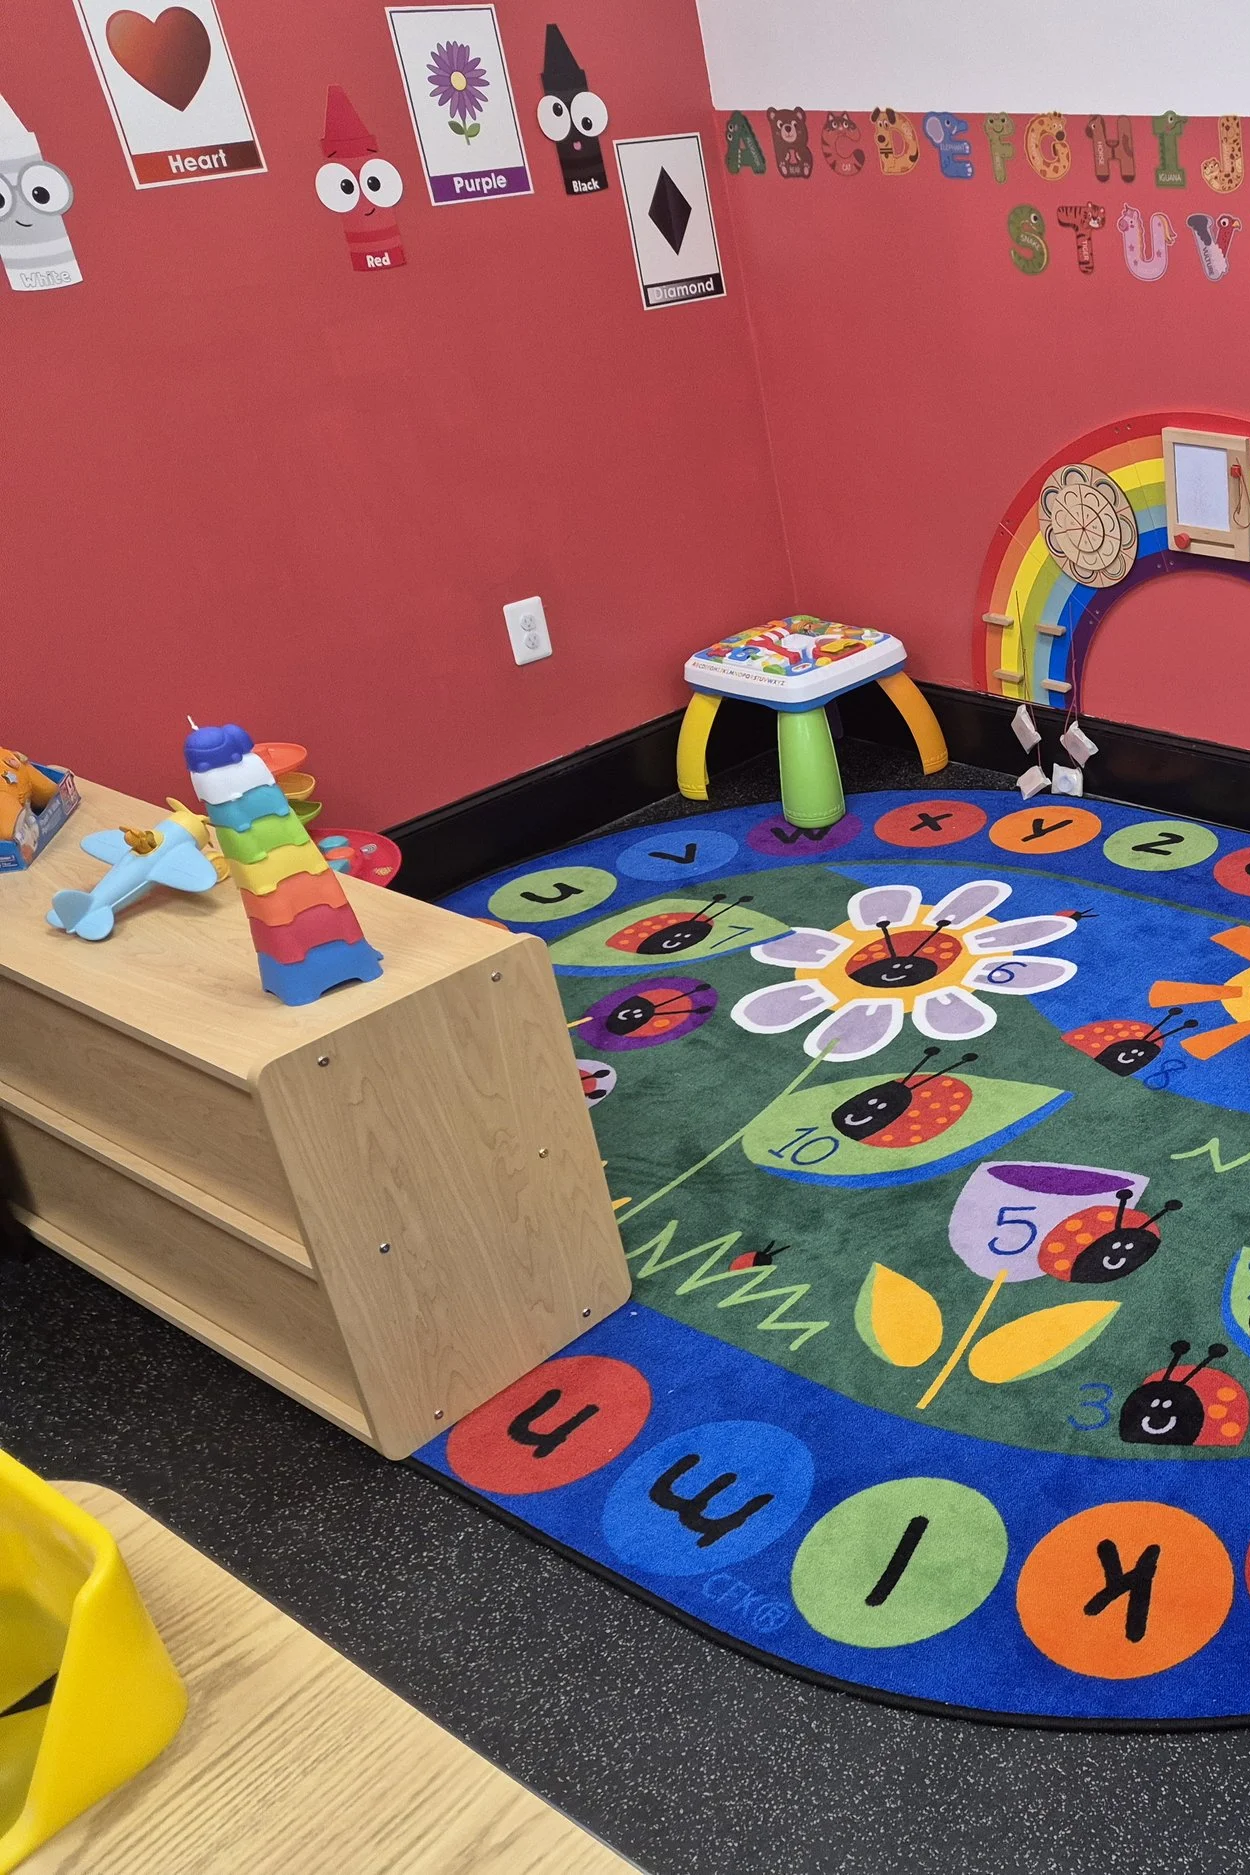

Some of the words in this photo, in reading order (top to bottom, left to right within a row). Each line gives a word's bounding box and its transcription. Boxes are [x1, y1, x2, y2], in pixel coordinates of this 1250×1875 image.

[167, 149, 228, 174] Heart
[453, 172, 507, 194] Purple
[572, 178, 600, 193] Black
[1158, 173, 1182, 182] IGUANA
[1020, 234, 1041, 250] SNAKE
[1081, 240, 1090, 261] TIGER
[366, 252, 391, 268] Red
[1202, 246, 1215, 276] VULTURE
[20, 270, 72, 288] White
[654, 277, 715, 299] Diamond
[521, 882, 583, 904] u
[649, 842, 697, 864] v
[910, 812, 953, 832] x
[1022, 819, 1073, 842] y
[1132, 832, 1185, 856] z
[710, 925, 755, 949] 7
[987, 961, 1028, 984] 6
[1143, 1058, 1188, 1091] 8
[767, 1127, 840, 1166] 10
[988, 1206, 1039, 1257] 5
[1066, 1381, 1114, 1432] 3
[649, 1454, 774, 1548] m
[865, 1515, 930, 1607] l
[1084, 1539, 1160, 1643] k
